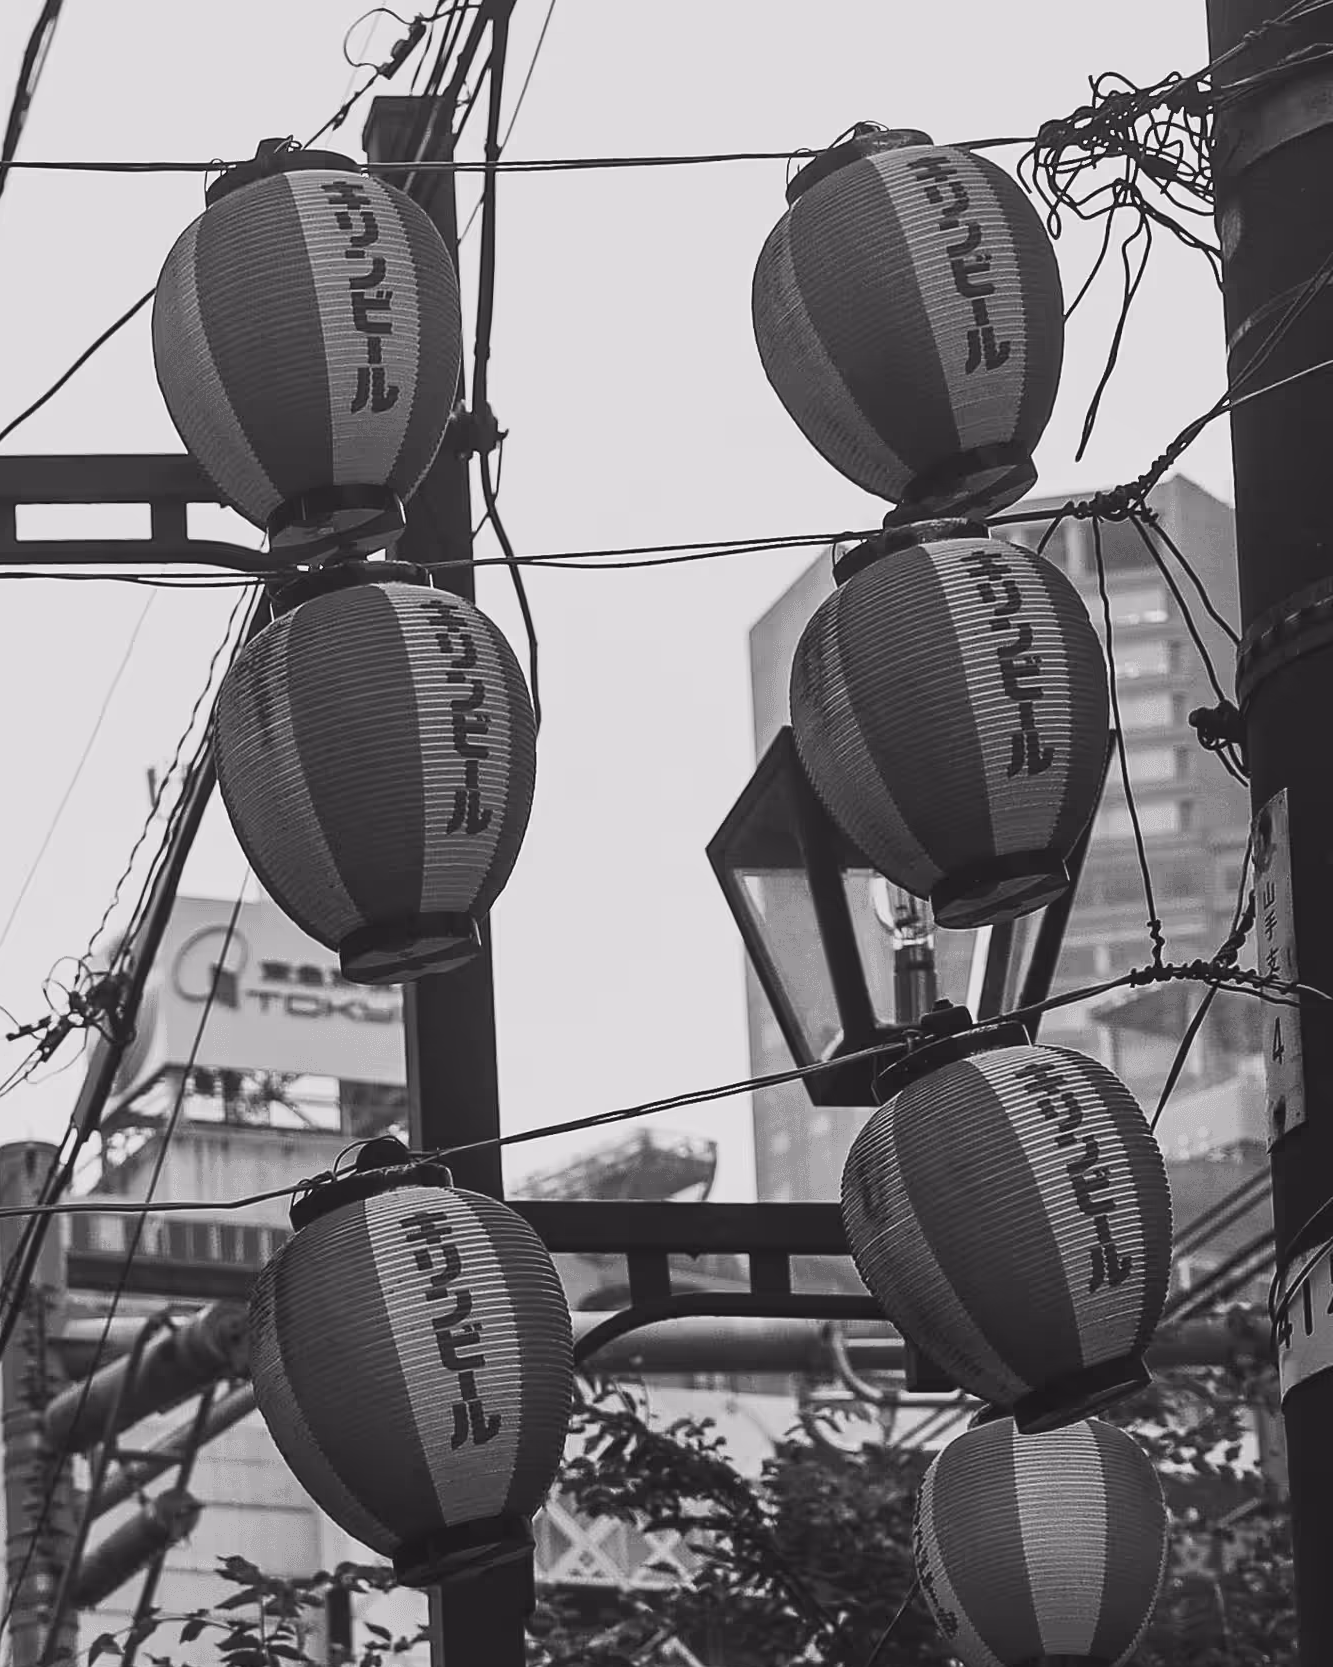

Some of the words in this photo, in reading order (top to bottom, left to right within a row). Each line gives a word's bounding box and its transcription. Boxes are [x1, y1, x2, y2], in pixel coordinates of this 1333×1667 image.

[321, 180, 400, 415] キリンビール
[908, 156, 1011, 375] キリンビール
[421, 600, 493, 836] キリンビール
[960, 551, 1054, 778] キリンビール
[1014, 1062, 1132, 1293] キリンビール
[400, 1211, 501, 1450] キリンビール
